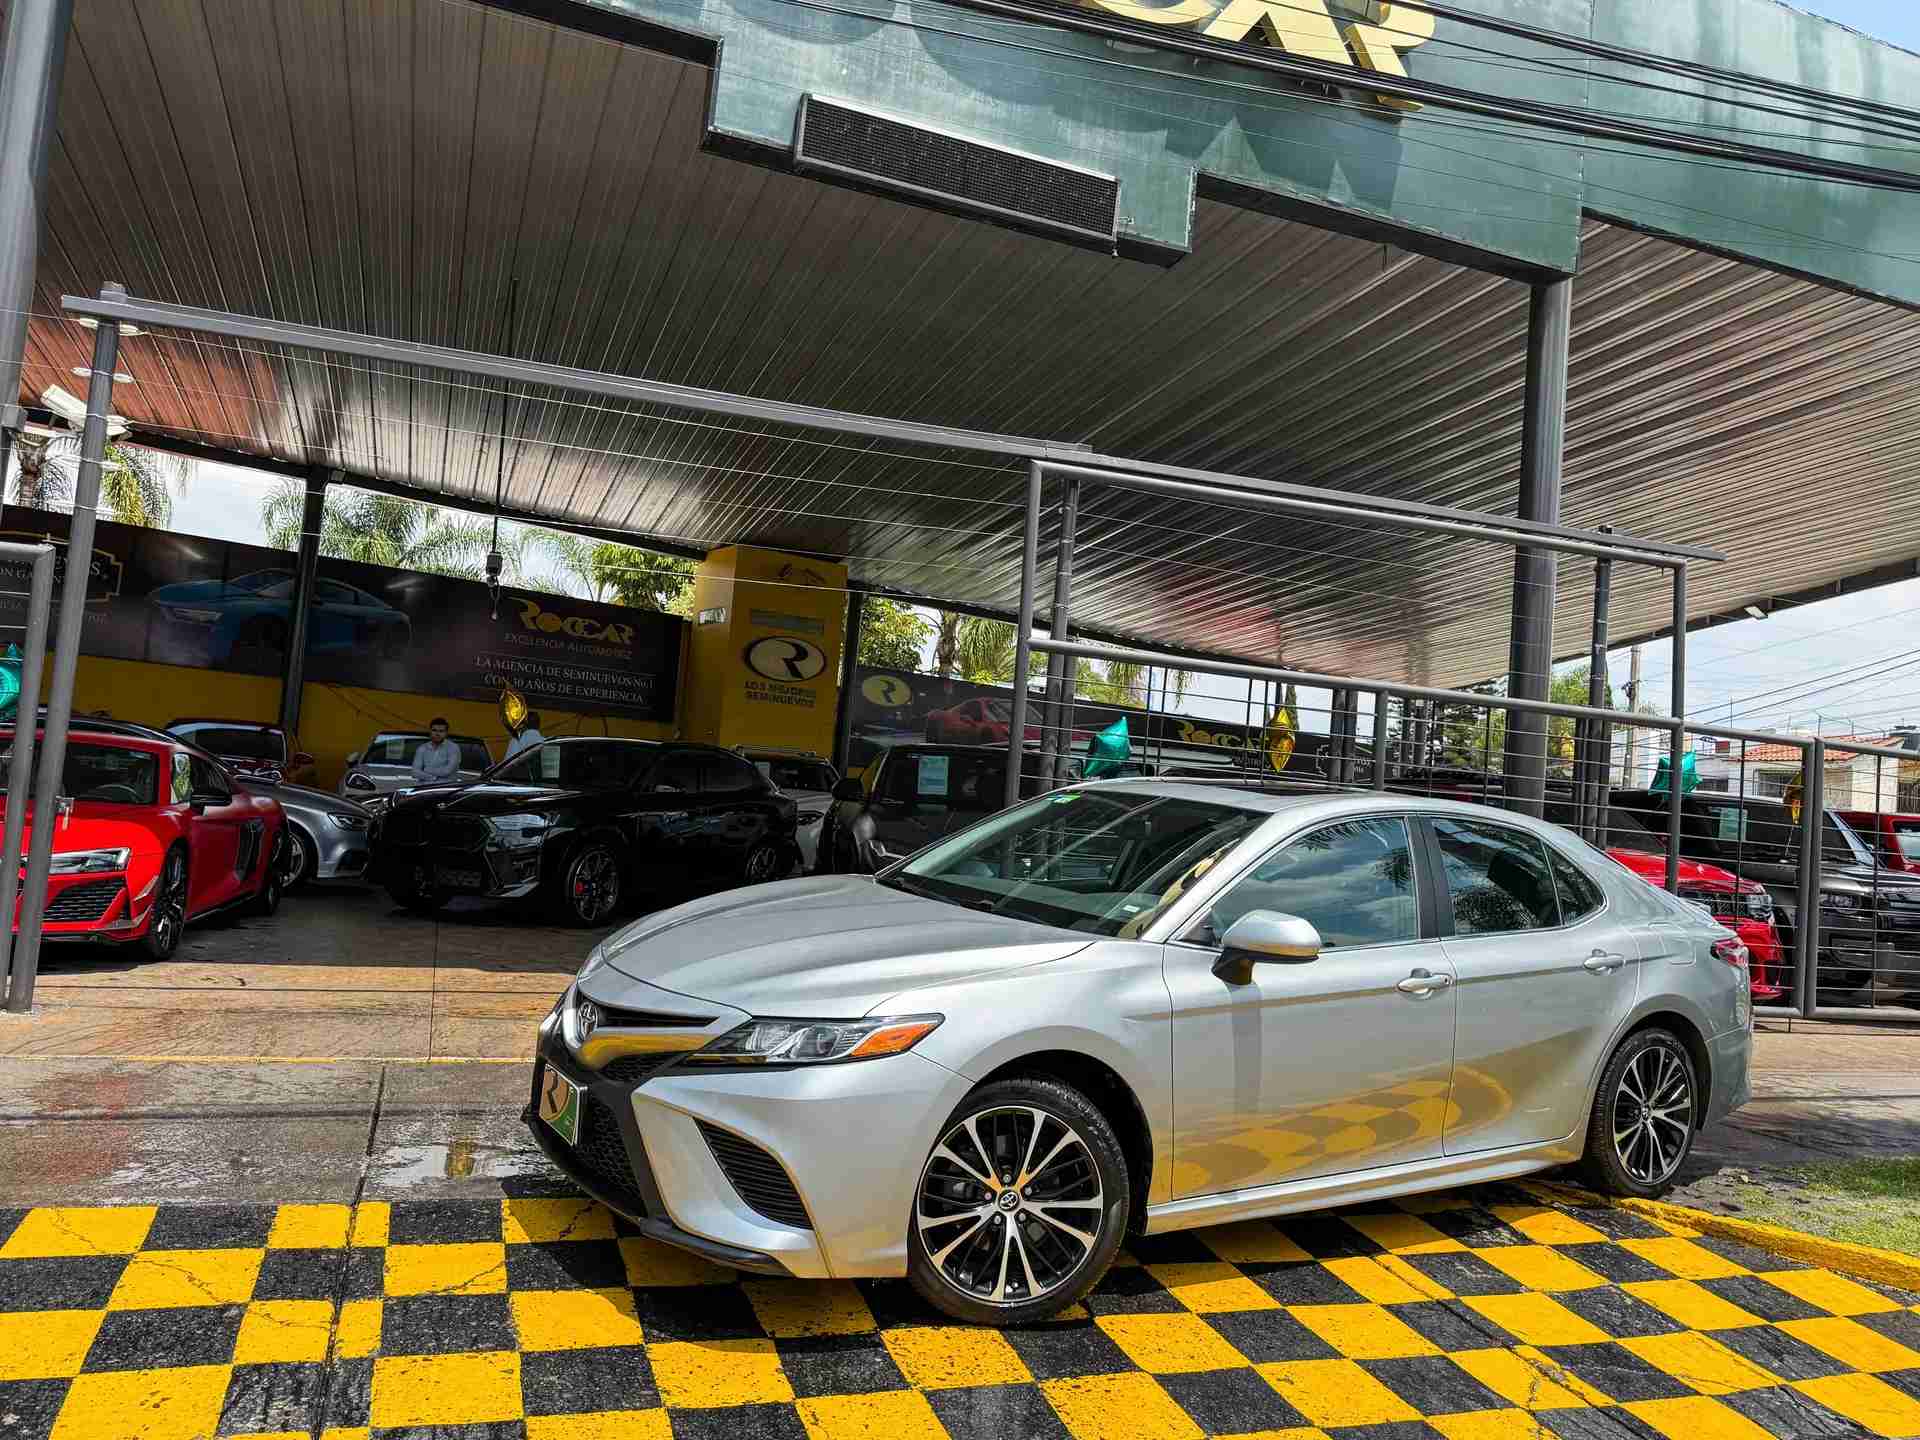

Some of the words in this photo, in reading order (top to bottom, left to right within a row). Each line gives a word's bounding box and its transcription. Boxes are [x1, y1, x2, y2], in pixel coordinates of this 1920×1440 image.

[475, 655, 493, 668] LA
[494, 659, 544, 675] AGENCIA
[546, 667, 562, 678] DE
[527, 676, 556, 693] AÑOS
[557, 683, 574, 696] DE
[574, 686, 645, 705] EXPERIENCIA
